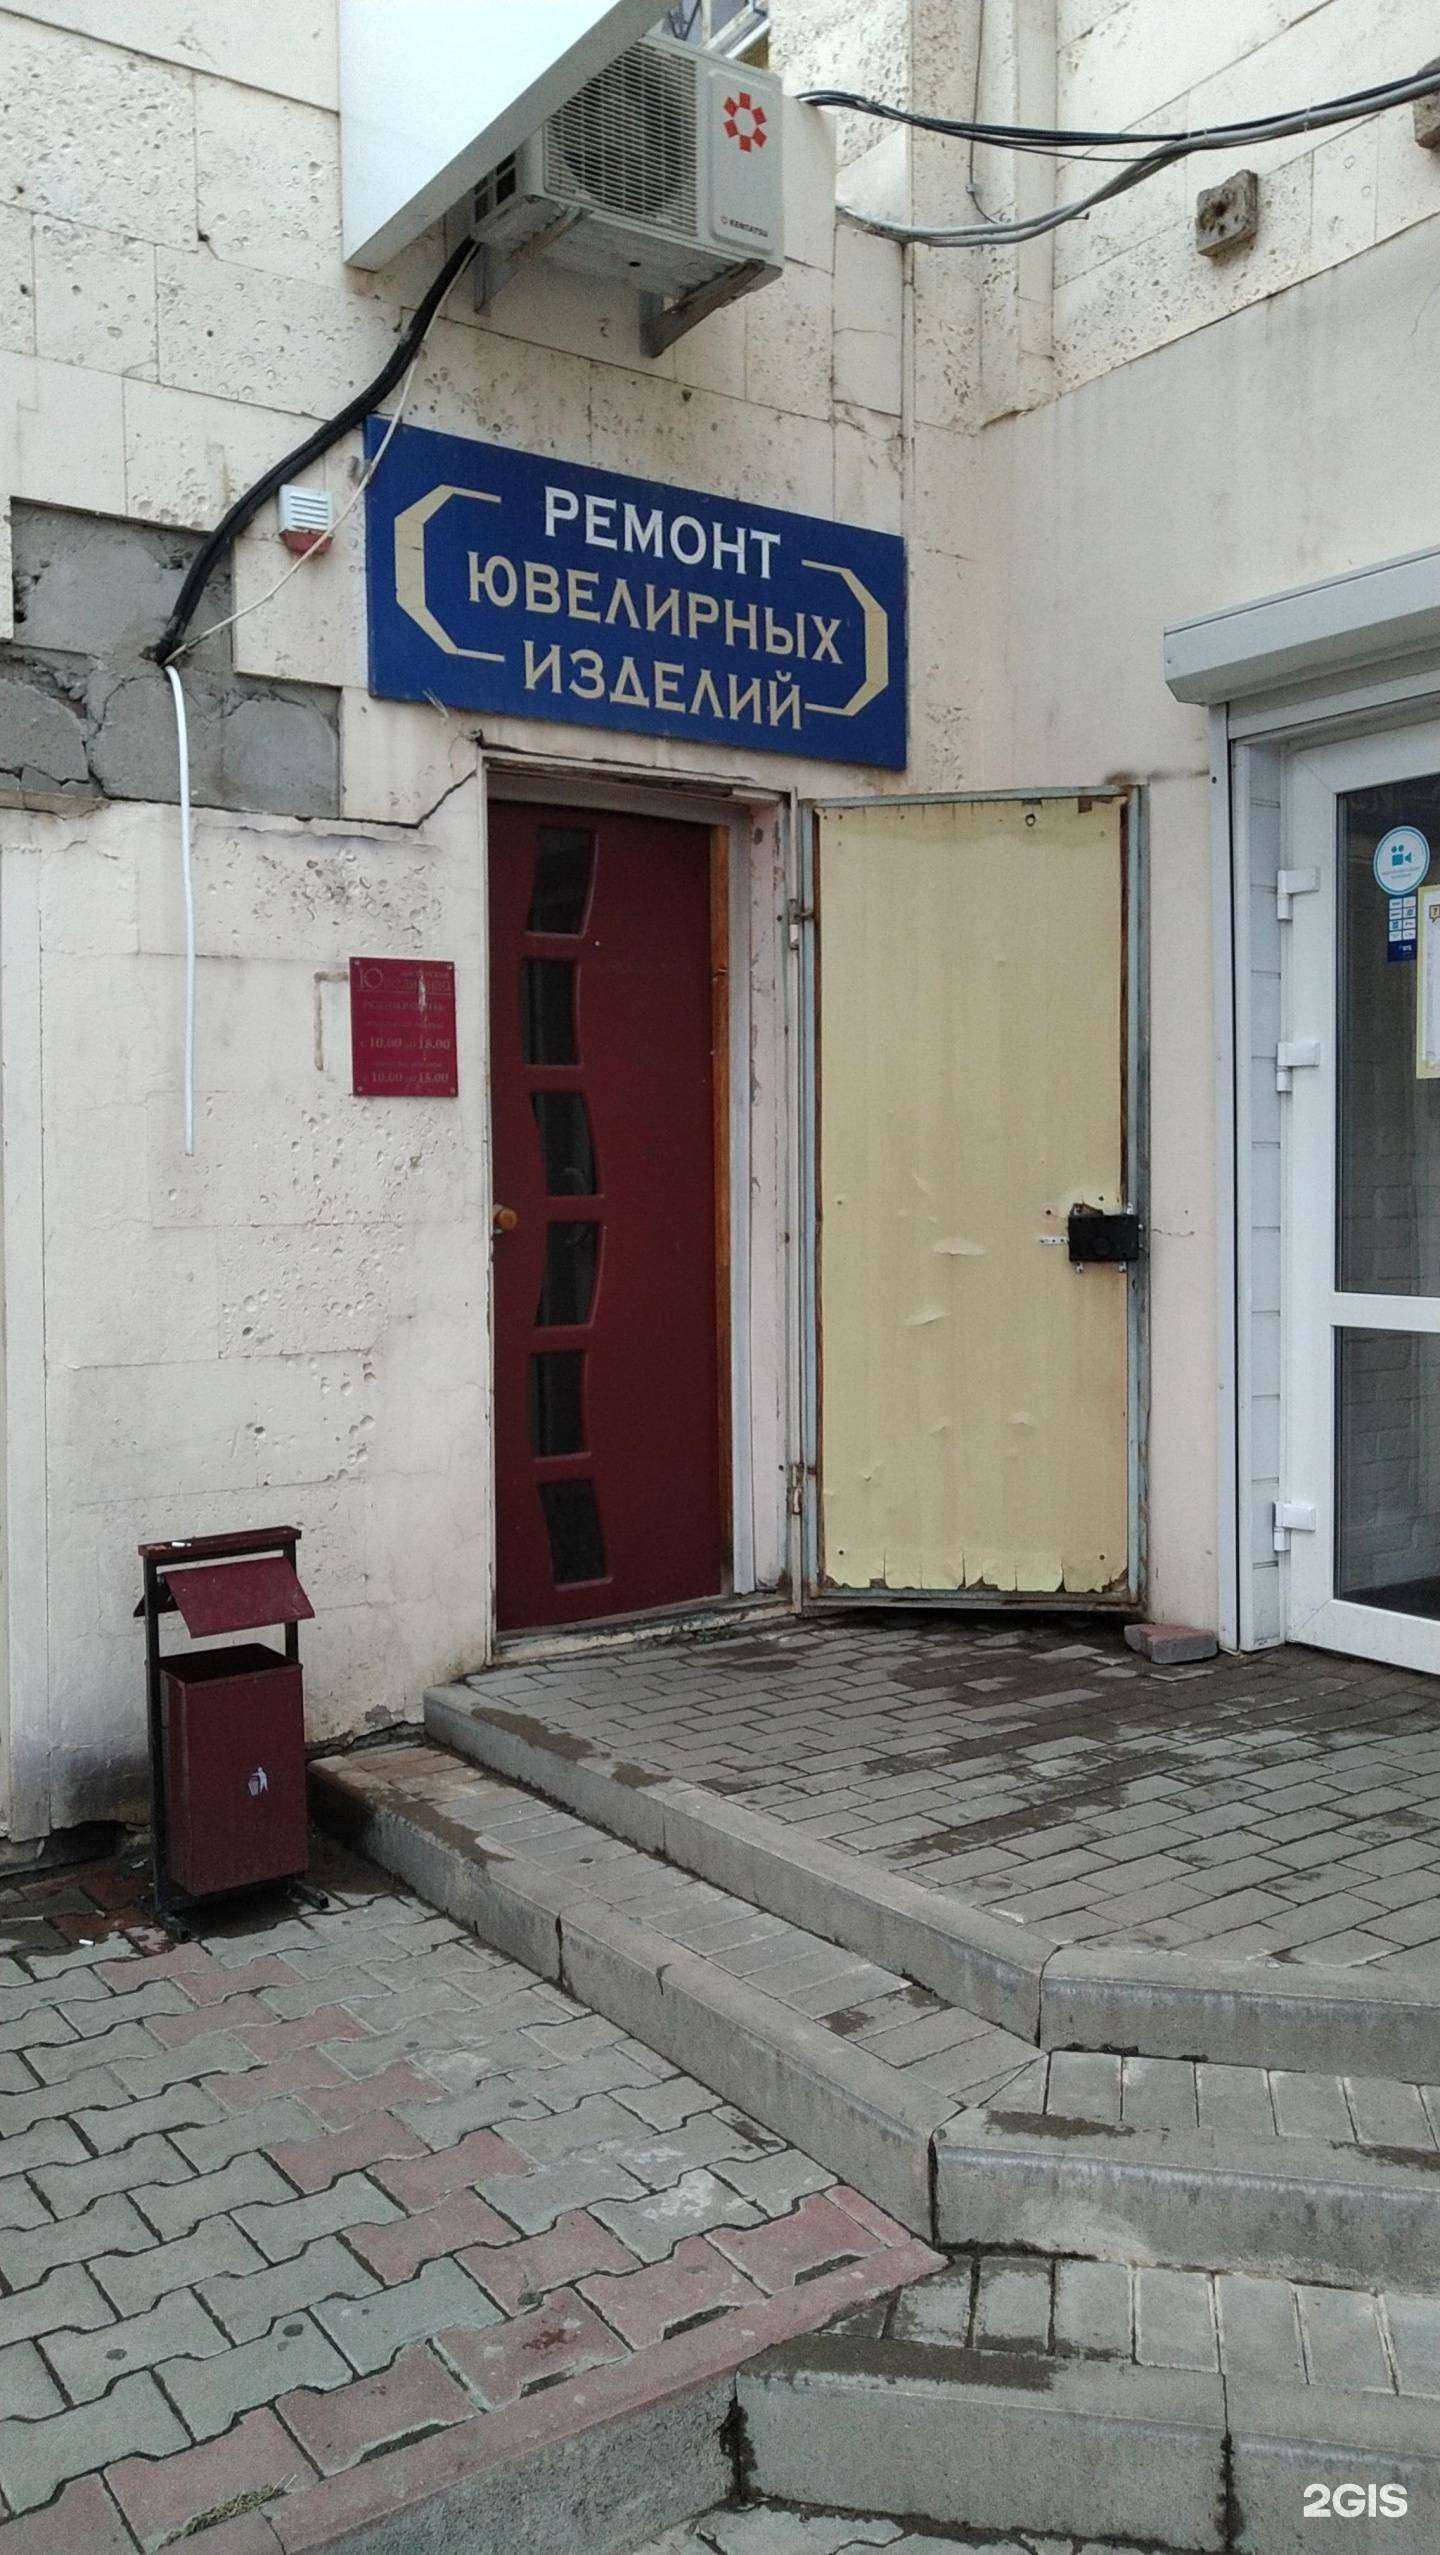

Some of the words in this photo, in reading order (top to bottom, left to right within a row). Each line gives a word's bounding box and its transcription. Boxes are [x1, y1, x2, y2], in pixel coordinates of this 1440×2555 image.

[545, 486, 781, 579] РЕМОНТ
[467, 551, 843, 665] ЮВЕЛИРНЫХ
[523, 639, 802, 730] ИЗДЕЛИЙ
